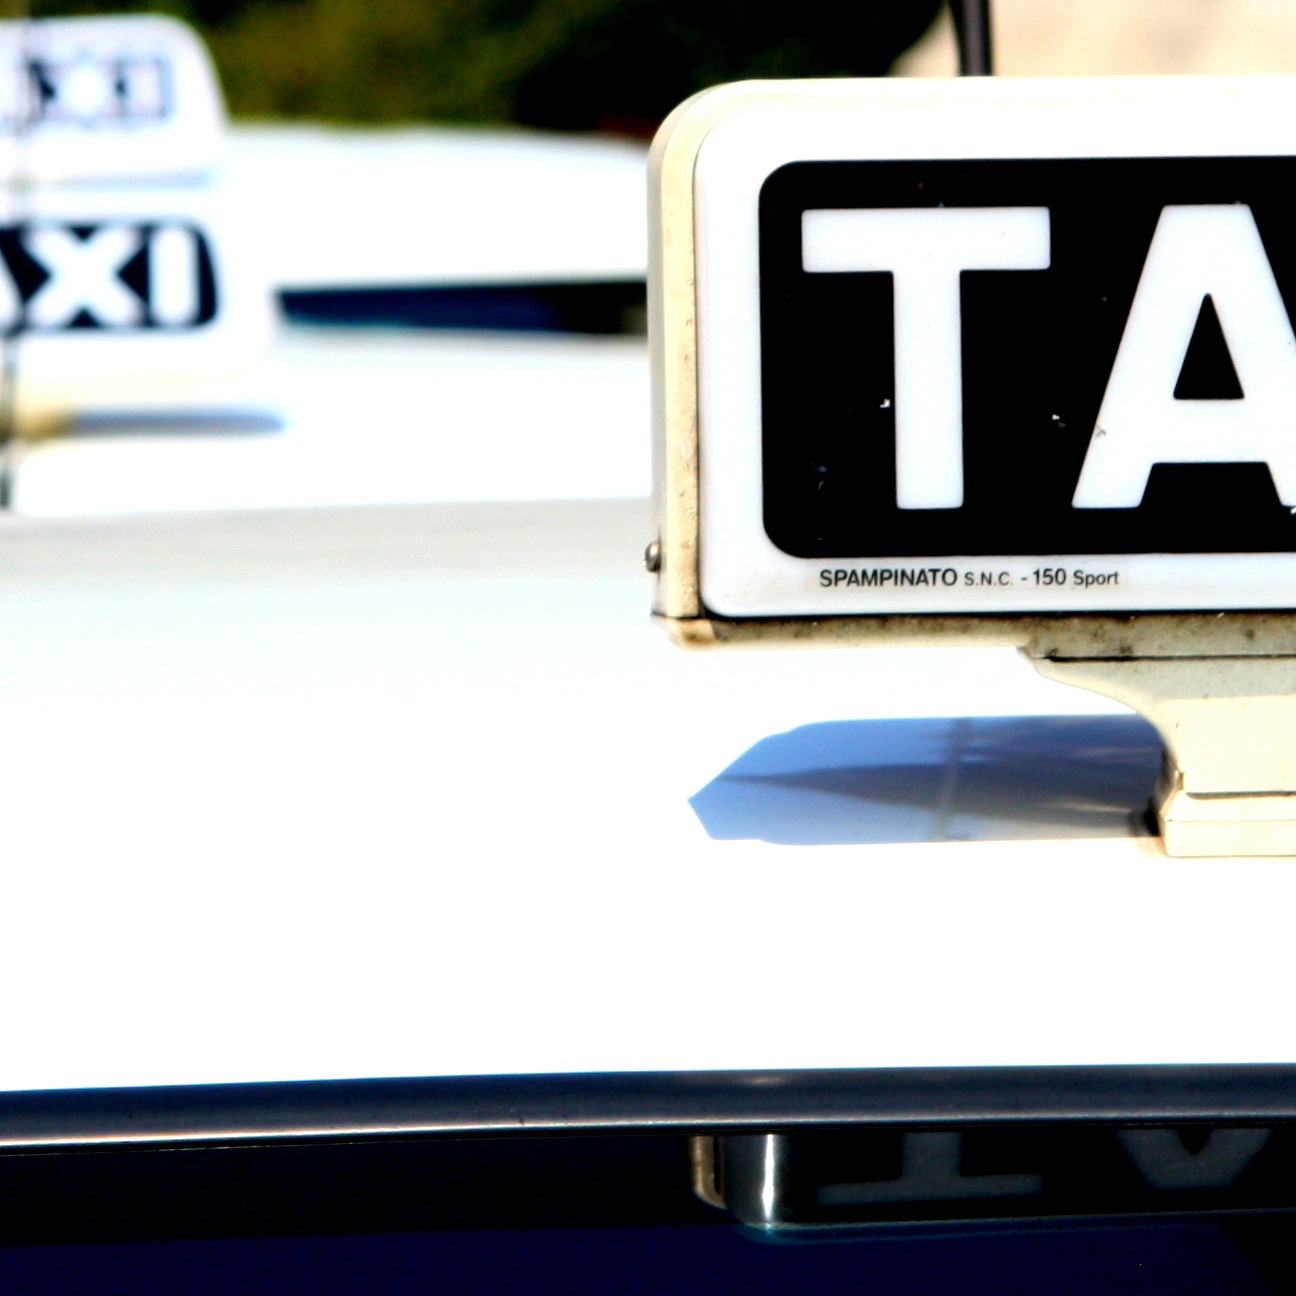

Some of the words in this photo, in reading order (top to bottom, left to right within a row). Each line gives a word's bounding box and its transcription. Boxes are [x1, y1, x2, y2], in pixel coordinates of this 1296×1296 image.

[819, 567, 958, 588] SPAMPINATO
[964, 571, 1014, 586] S.N.C.
[1032, 567, 1067, 586] 150
[1073, 569, 1119, 589] Sport
